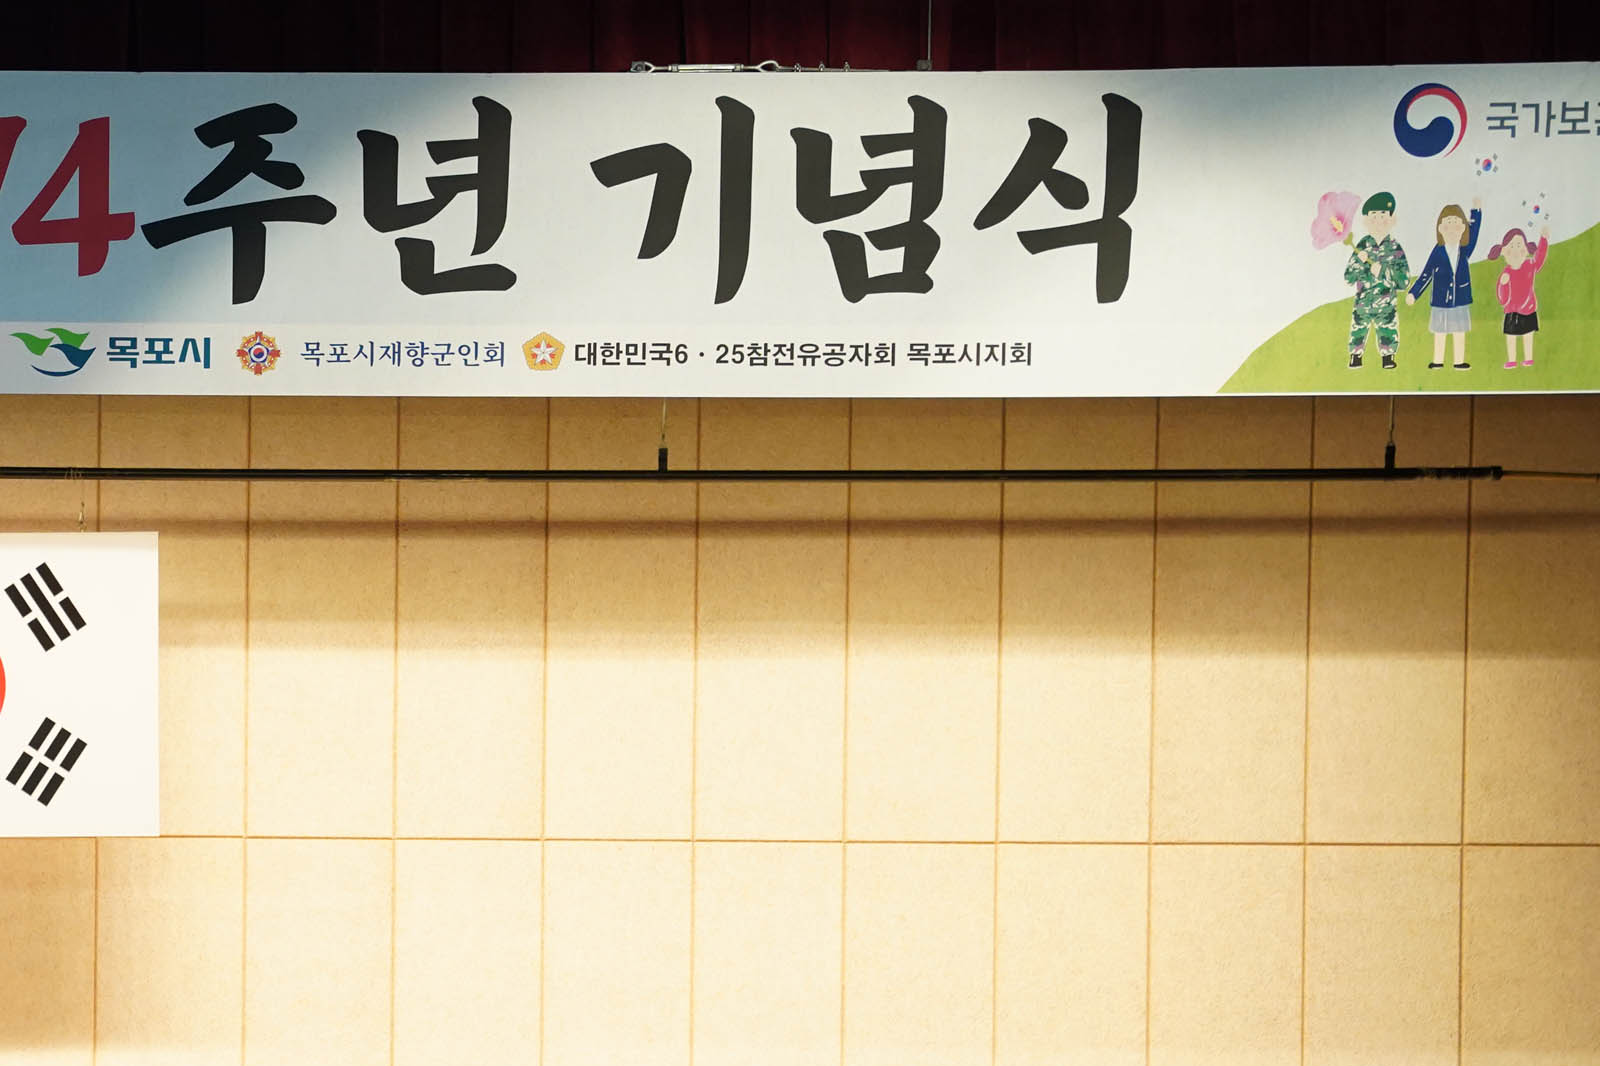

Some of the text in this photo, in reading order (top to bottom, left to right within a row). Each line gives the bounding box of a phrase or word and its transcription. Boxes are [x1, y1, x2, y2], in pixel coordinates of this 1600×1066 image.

[590, 93, 1142, 304] 기념식
[106, 336, 211, 370] 목포시
[300, 340, 504, 368] 목포시재향군인회
[906, 342, 1032, 367] 목포시지회
